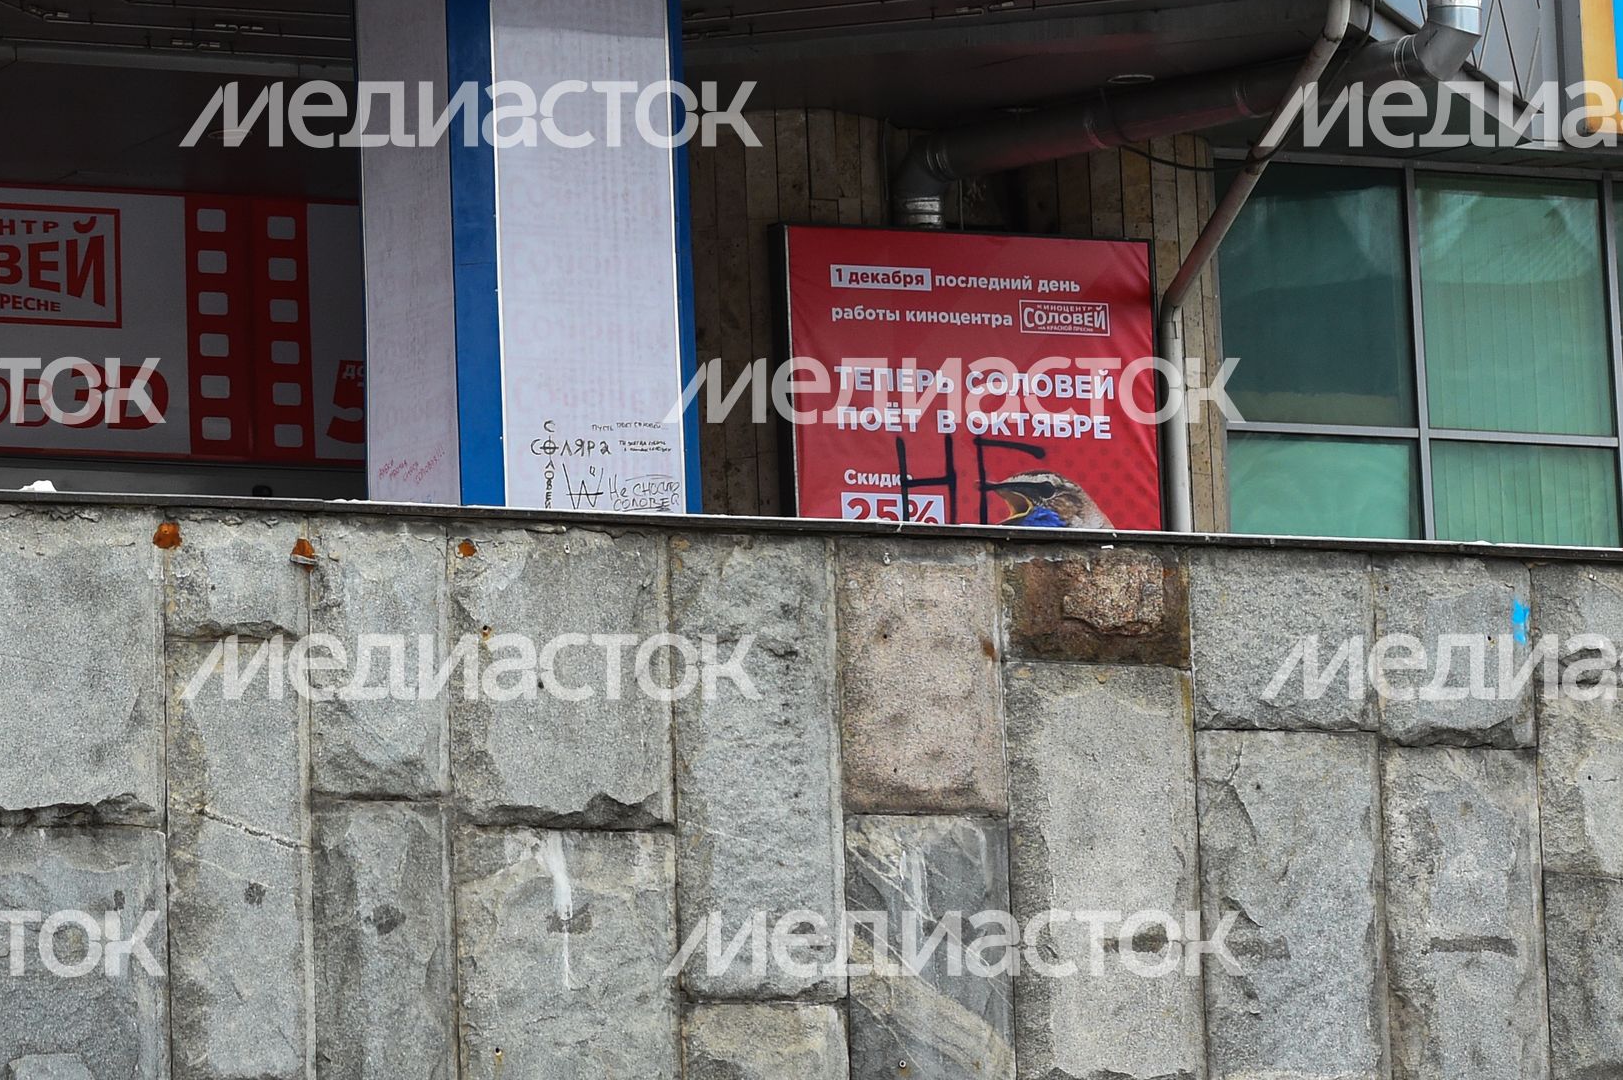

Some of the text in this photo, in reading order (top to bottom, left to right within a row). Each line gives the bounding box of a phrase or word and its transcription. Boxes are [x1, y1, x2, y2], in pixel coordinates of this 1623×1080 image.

[835, 268, 1081, 293] 1 декабря последний день
[831, 305, 1013, 328] работы киноцентра
[1023, 305, 1106, 331] СОЛОВЕЙ
[834, 365, 1114, 400] ТЕПЕРЬ СОЛОВЕЙ
[836, 403, 1112, 439] ПОЁТ В ОКТЯБРЕ
[844, 469, 912, 487] Скидк
